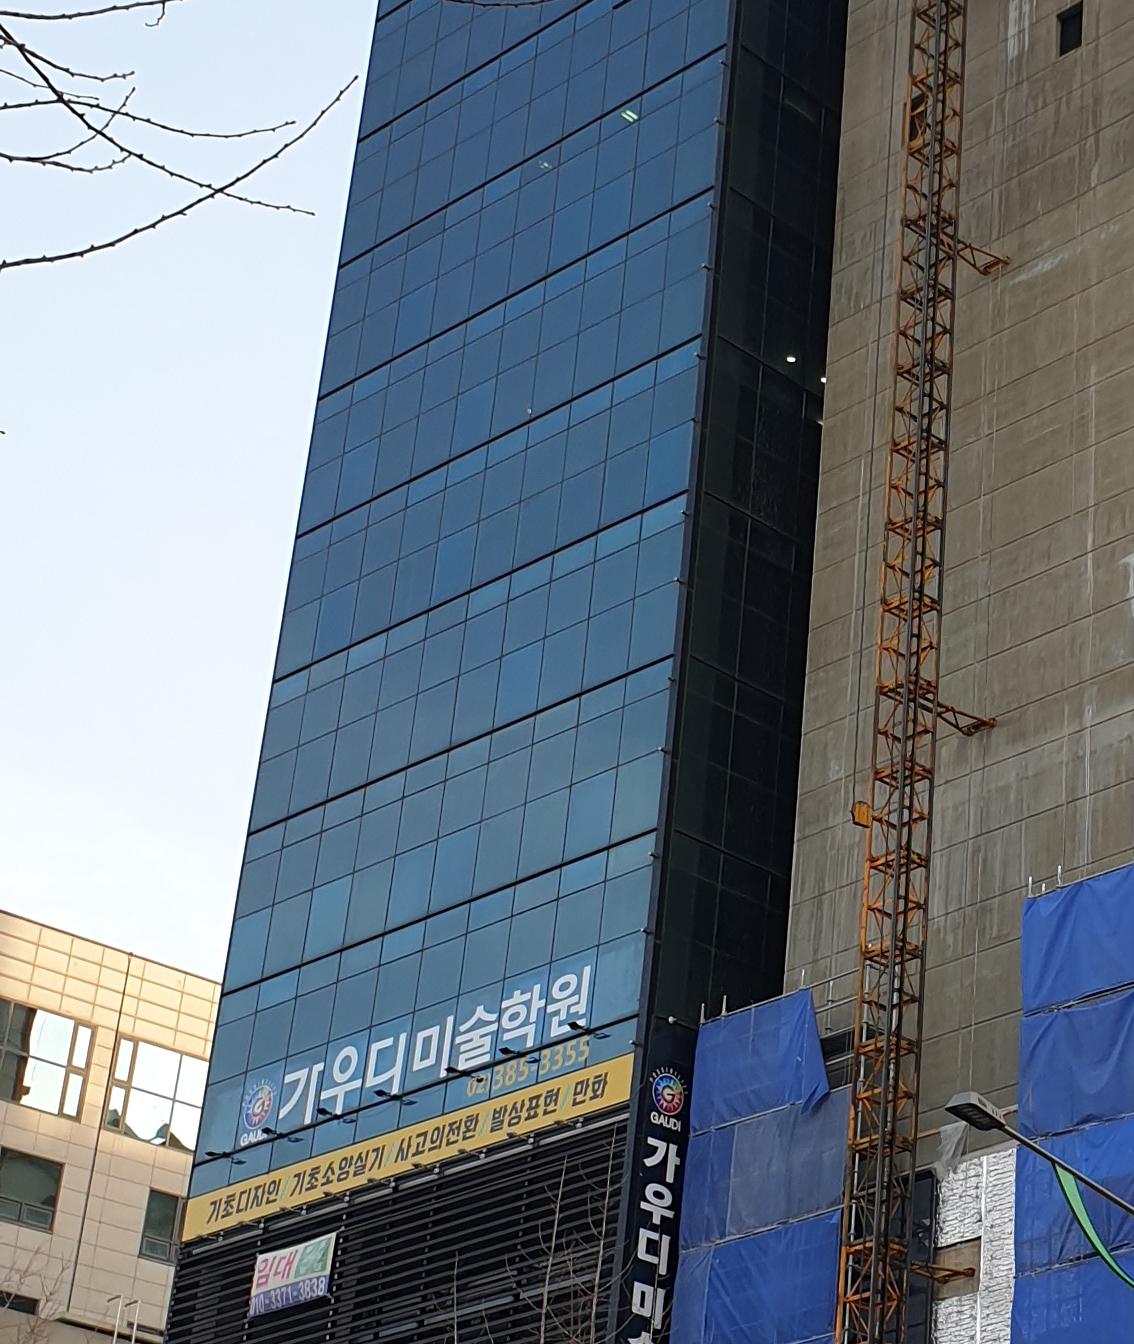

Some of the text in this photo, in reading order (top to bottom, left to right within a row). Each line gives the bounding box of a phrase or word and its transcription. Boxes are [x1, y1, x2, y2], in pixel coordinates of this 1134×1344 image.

[278, 965, 592, 1126] 가우디미술학원
[205, 1070, 609, 1225] 기초디자인 기초소양실기 사고의전환 발상표현 만화
[650, 1111, 681, 1132] GAUDI
[256, 1249, 298, 1290] 임대
